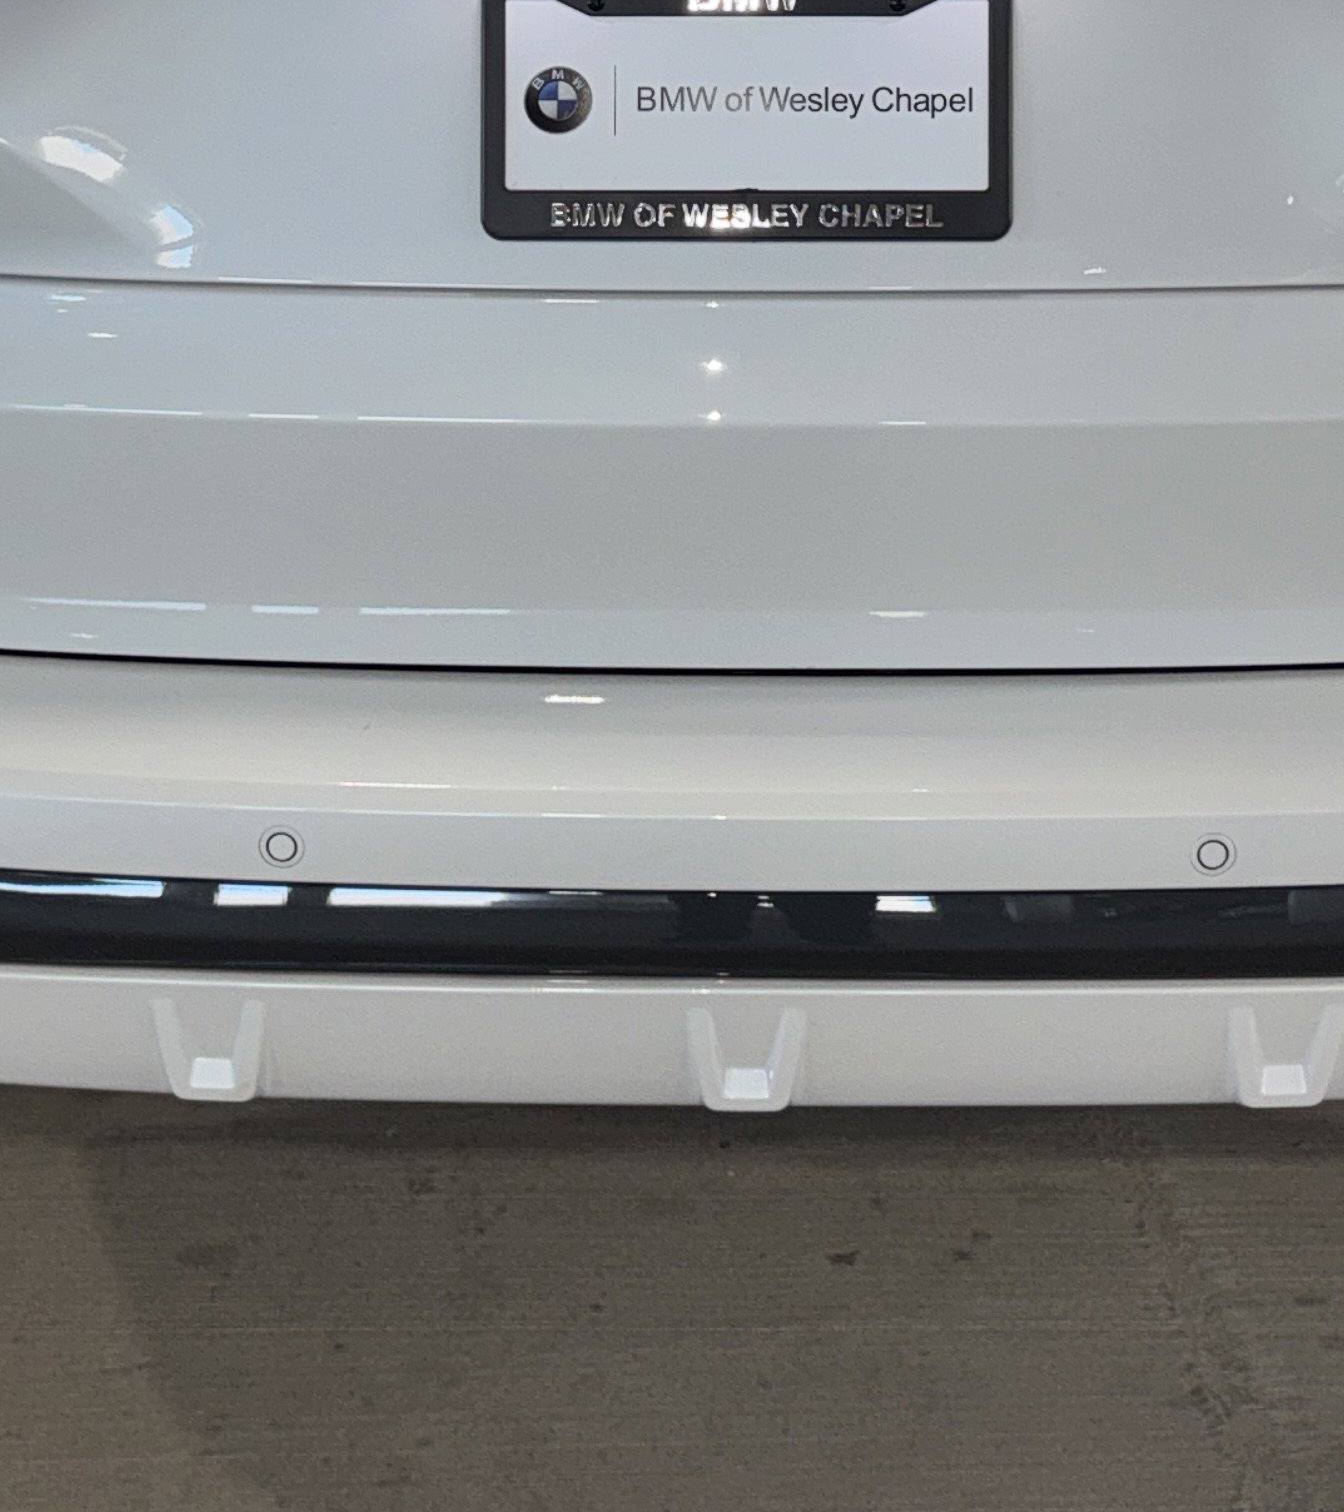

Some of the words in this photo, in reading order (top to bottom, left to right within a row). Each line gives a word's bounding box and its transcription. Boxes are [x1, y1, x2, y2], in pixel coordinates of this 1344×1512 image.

[532, 69, 584, 90] BMW
[637, 86, 717, 112] BMW
[725, 86, 754, 112] of
[759, 86, 864, 119] Wesley
[872, 86, 973, 119] Chapel
[551, 202, 625, 227] BMW
[634, 202, 676, 228] OF
[682, 203, 809, 230] WESLEY
[819, 204, 944, 229] CHAPEL
